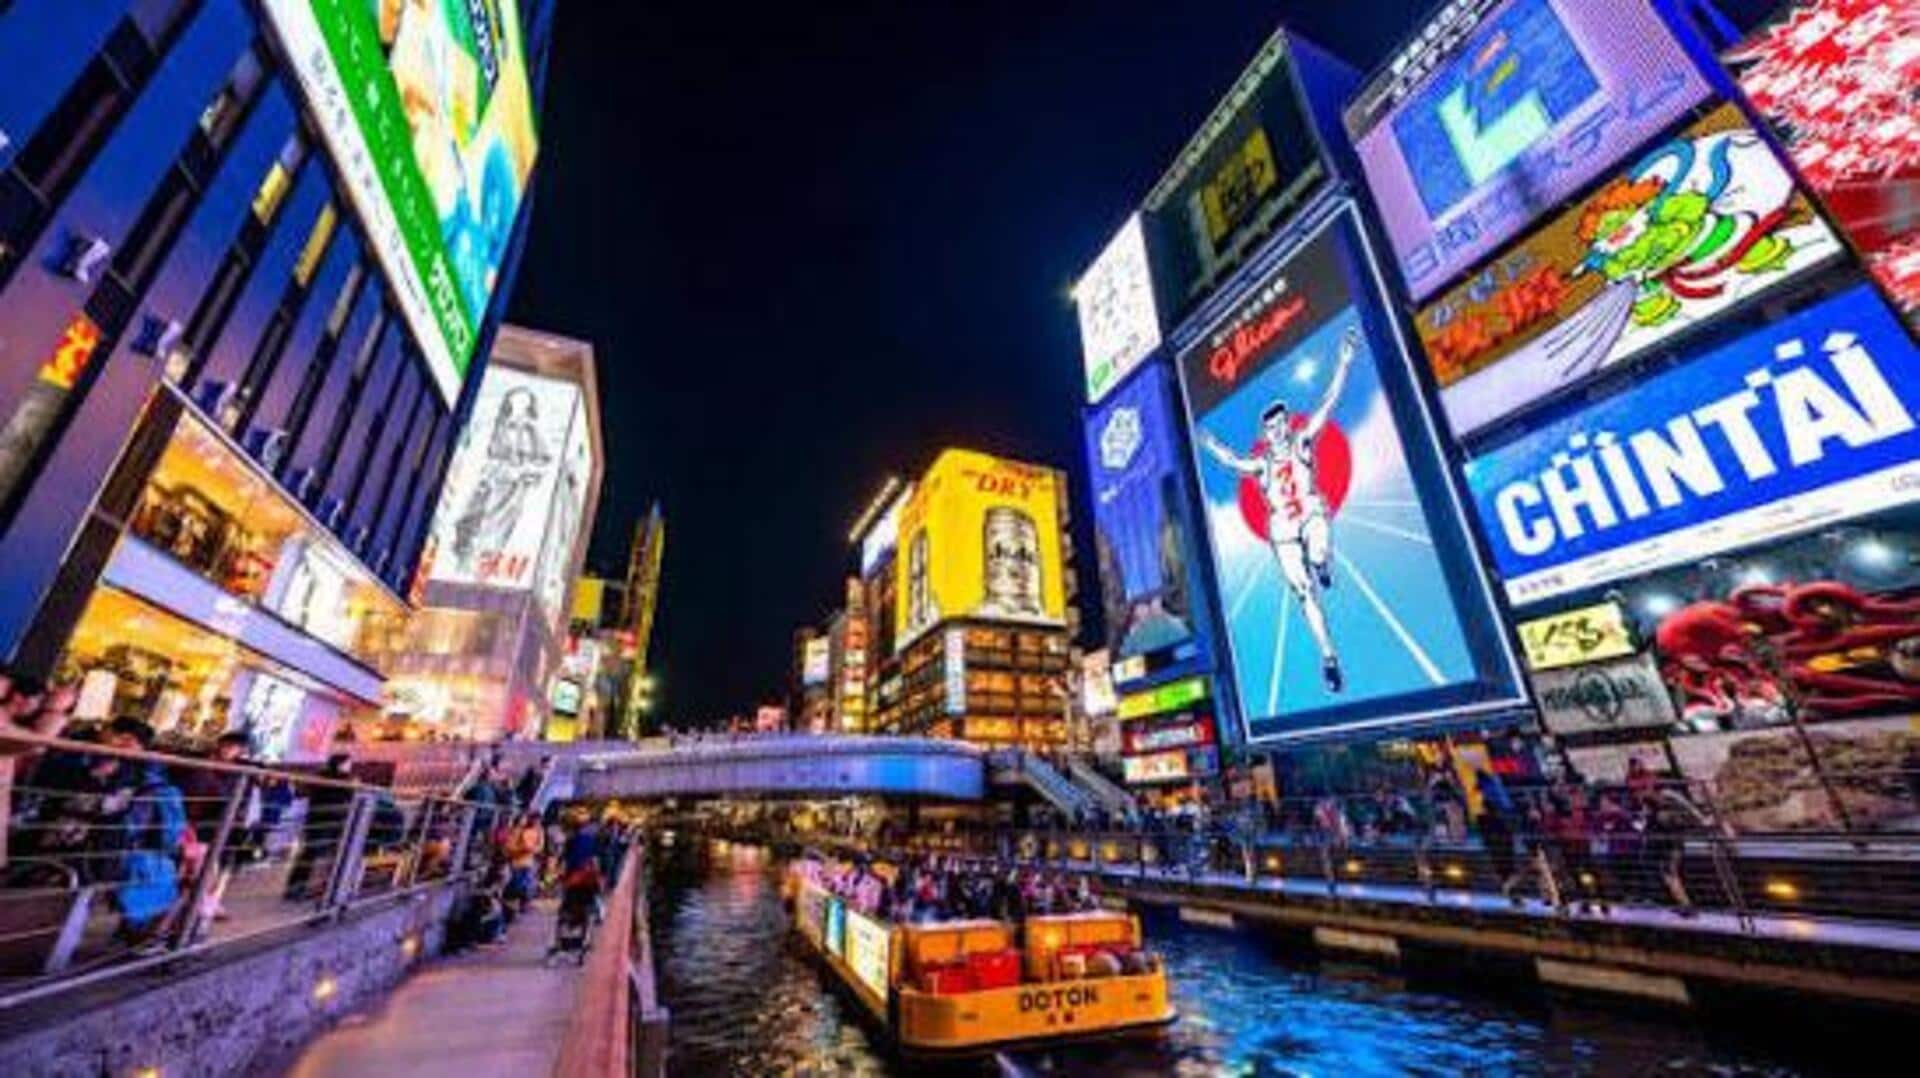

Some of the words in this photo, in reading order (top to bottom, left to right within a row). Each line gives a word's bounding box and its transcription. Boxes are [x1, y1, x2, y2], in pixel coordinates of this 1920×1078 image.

[1494, 332, 1916, 557] CHINTAI
[976, 474, 1034, 500] DRY
[1019, 987, 1098, 1012] DOTON
